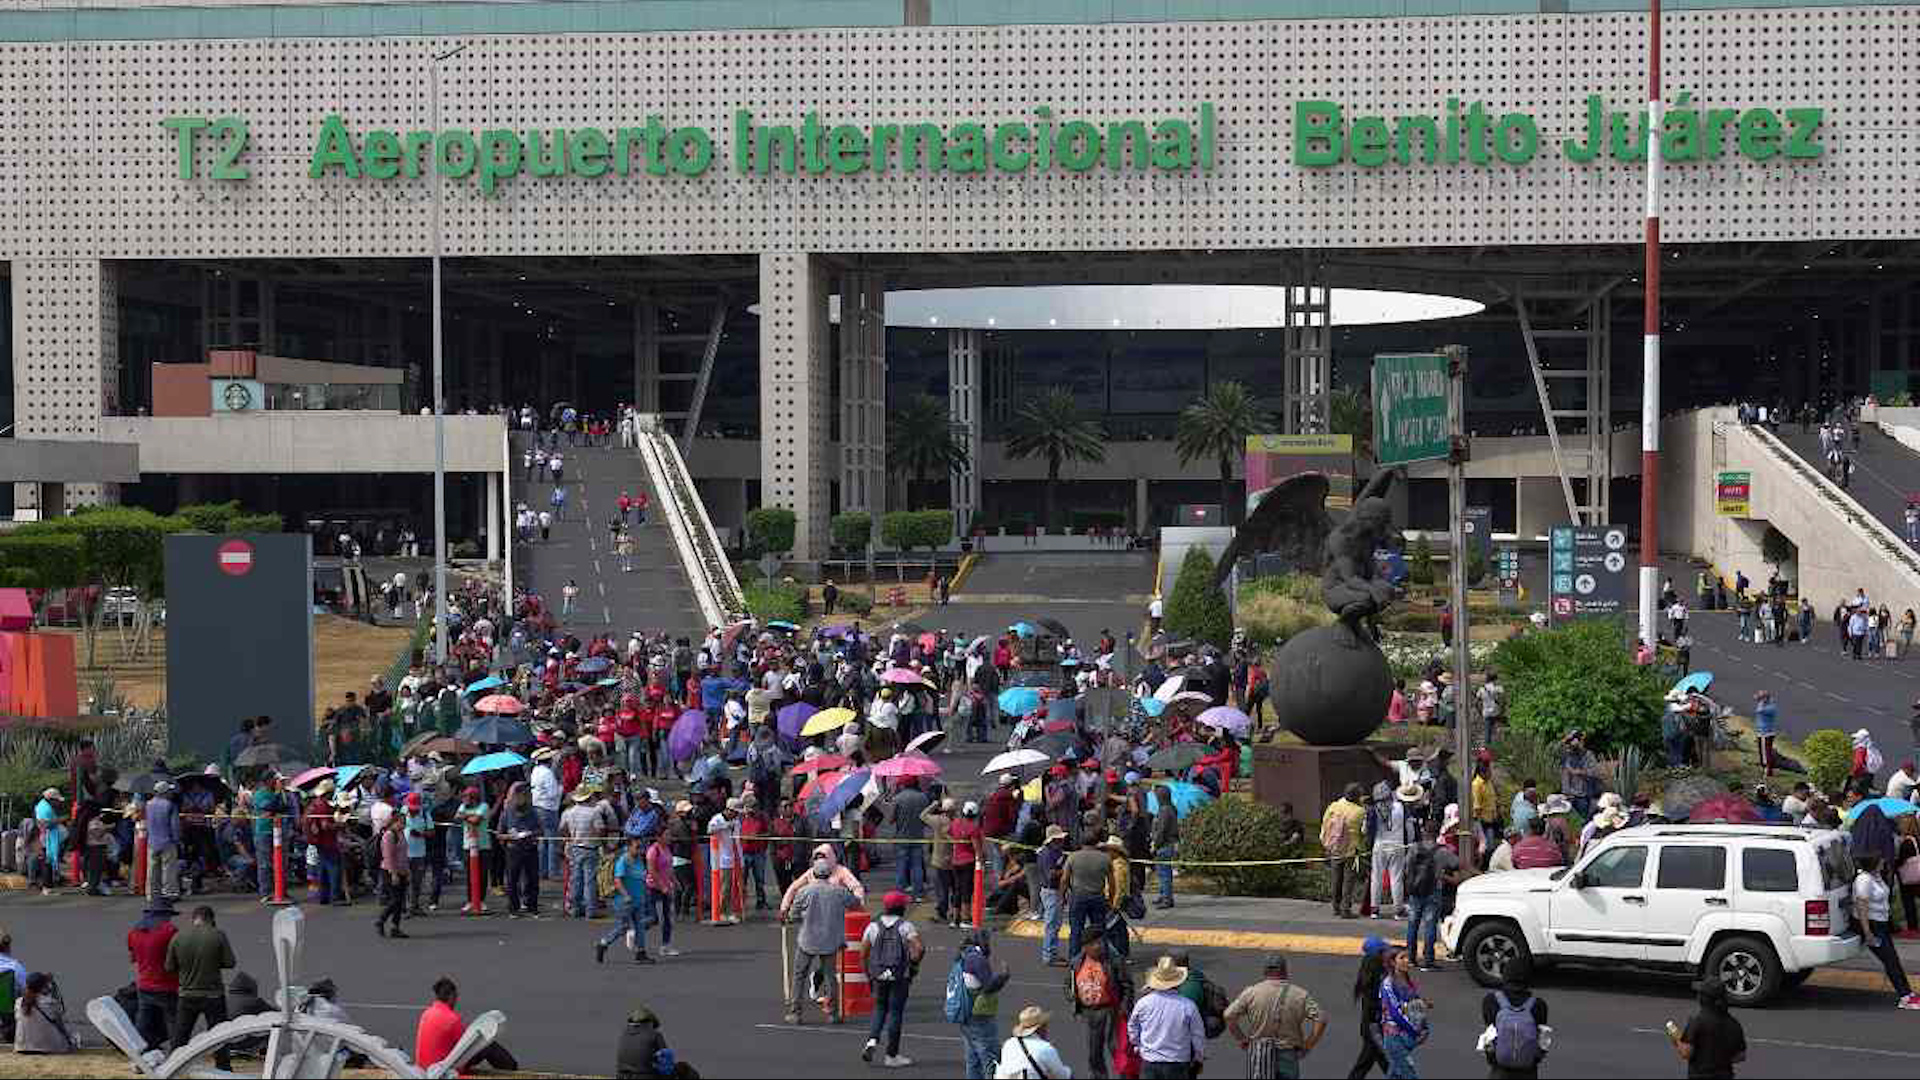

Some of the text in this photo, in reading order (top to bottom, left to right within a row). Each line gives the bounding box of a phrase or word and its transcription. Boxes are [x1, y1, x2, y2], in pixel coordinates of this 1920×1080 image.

[164, 91, 1826, 196] T2 Aeropuerto Internacional Benito Juárez
